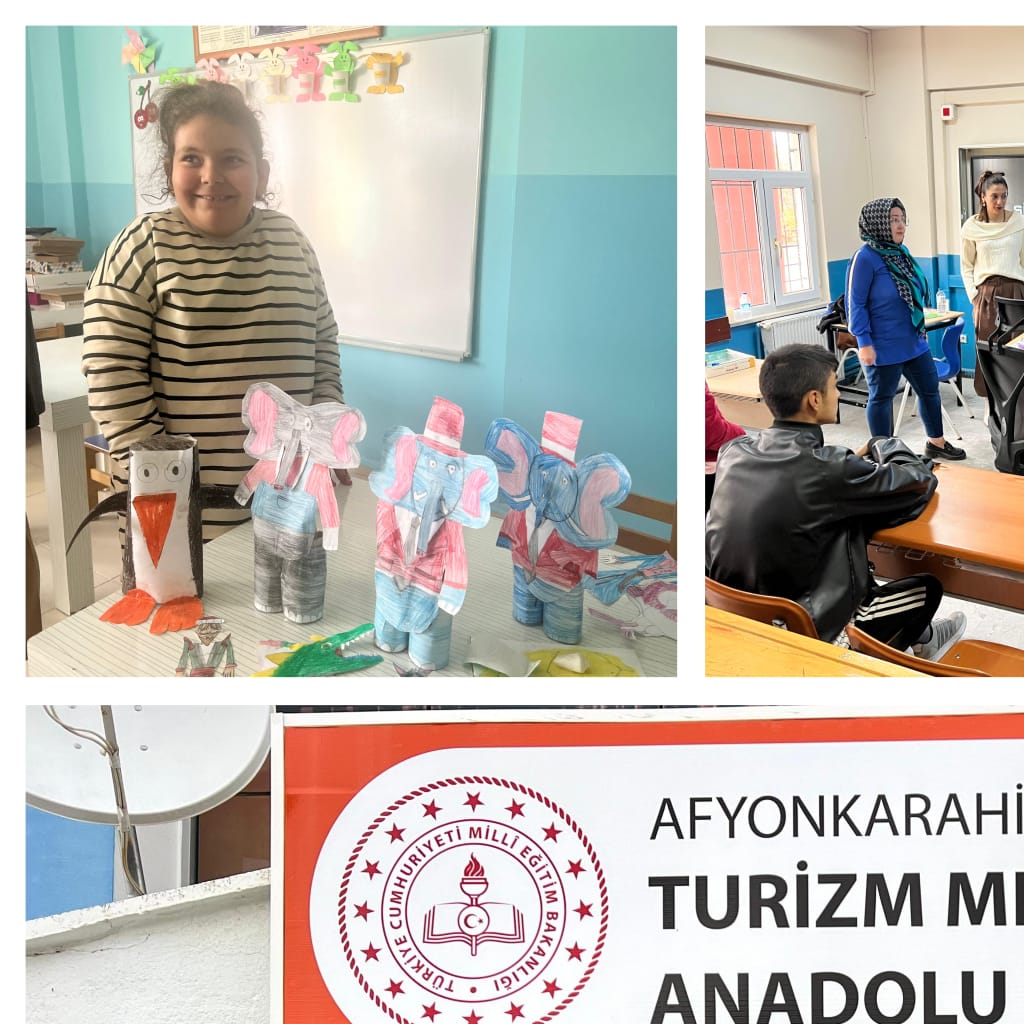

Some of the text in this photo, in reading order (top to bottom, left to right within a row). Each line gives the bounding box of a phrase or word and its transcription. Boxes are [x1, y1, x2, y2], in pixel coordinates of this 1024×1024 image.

[388, 825, 463, 930] CUMHURİYETİ
[519, 845, 559, 904] EĞİTİM
[648, 860, 924, 930] TURİZM
[394, 934, 455, 993] TÜRKİYE
[493, 910, 559, 992] BAKANLIĞI
